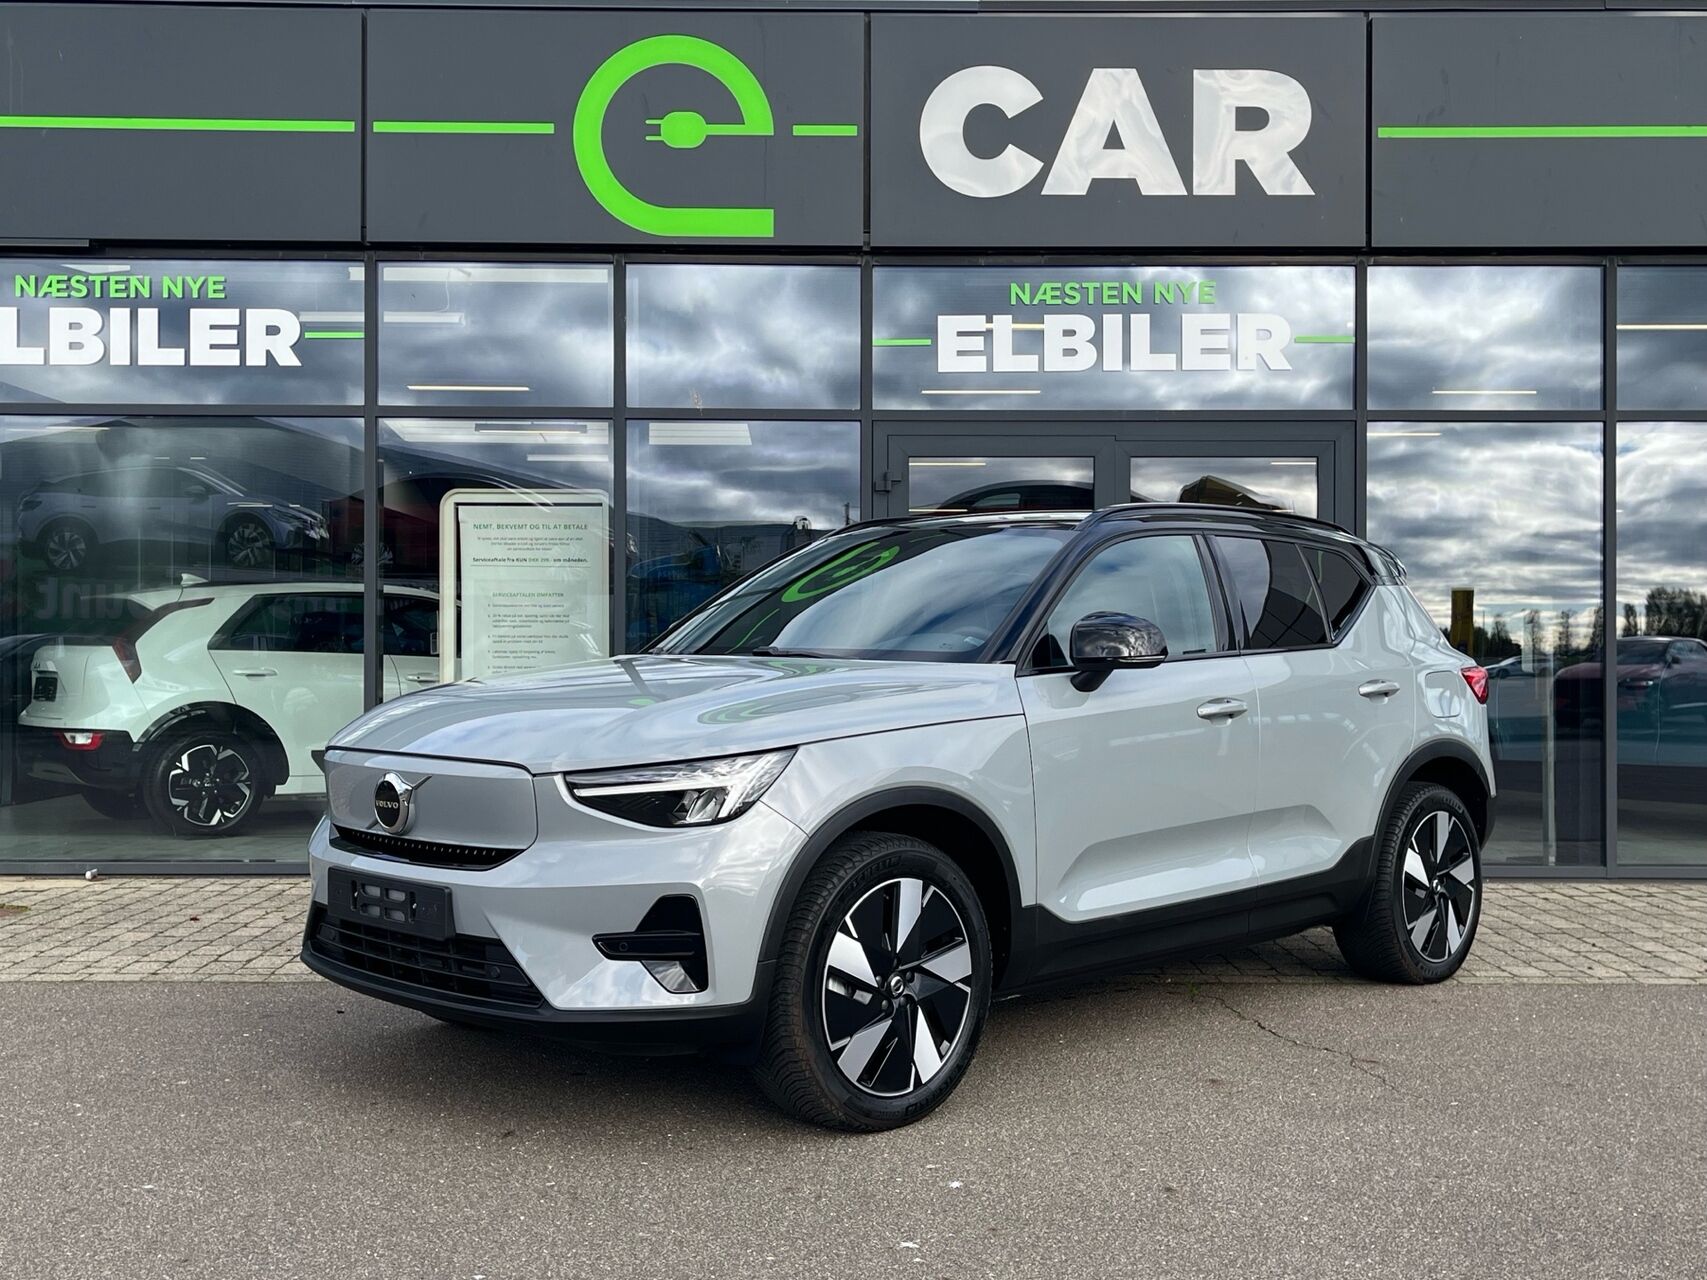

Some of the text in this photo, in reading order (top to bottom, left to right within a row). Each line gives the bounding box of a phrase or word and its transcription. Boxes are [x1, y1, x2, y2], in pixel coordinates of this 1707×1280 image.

[919, 65, 1316, 198] CAR
[15, 274, 226, 299] NÆSTEN NYE
[1009, 281, 1217, 305] NÆSTEN NYE
[937, 313, 1293, 373] ELBILER
[375, 799, 399, 809] VOLVO
